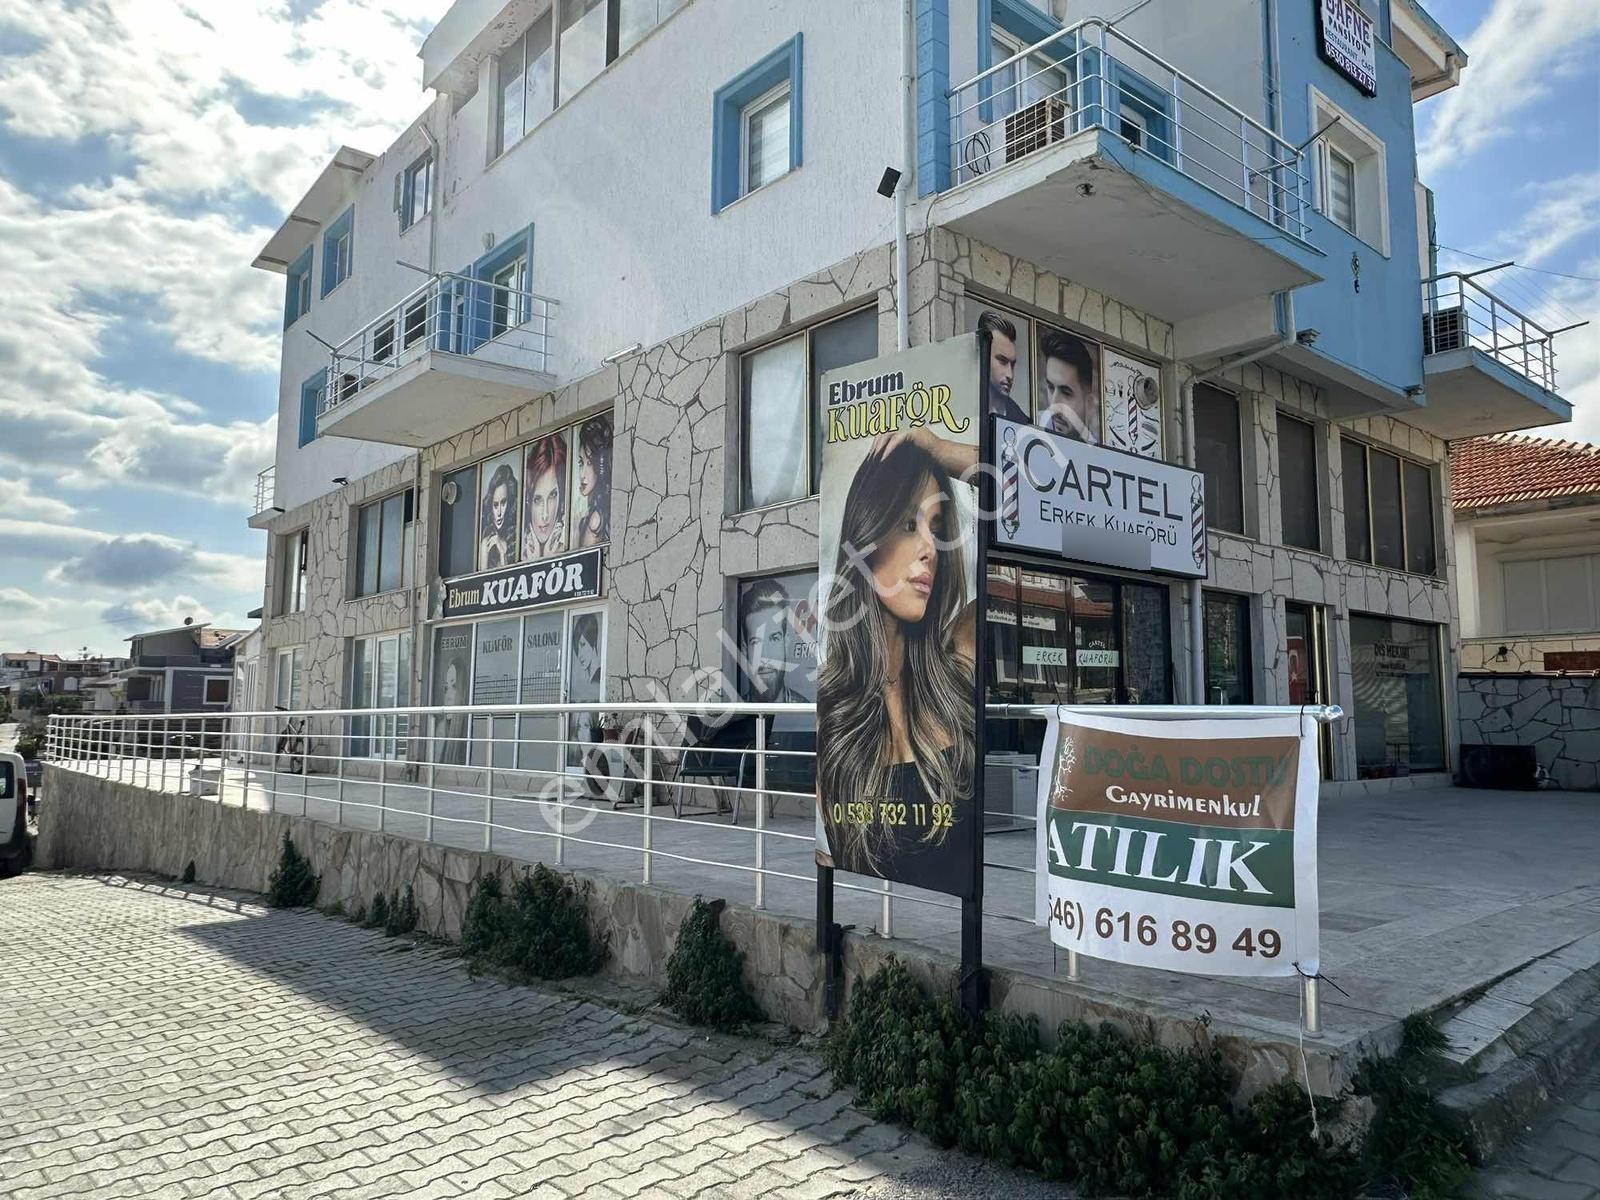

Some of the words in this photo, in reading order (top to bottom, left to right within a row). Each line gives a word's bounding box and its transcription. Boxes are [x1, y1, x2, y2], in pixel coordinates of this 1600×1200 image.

[828, 370, 905, 406] Ebrum
[1023, 437, 1184, 522] CARTEL
[449, 588, 481, 609] Ebrum
[480, 561, 584, 606] KUAFÖR
[1084, 744, 1170, 781] DOĞA
[879, 802, 907, 826] 732
[912, 803, 926, 827] 11
[1094, 907, 1158, 947] 616
[1170, 919, 1218, 954] 89
[1231, 927, 1282, 959] 49
